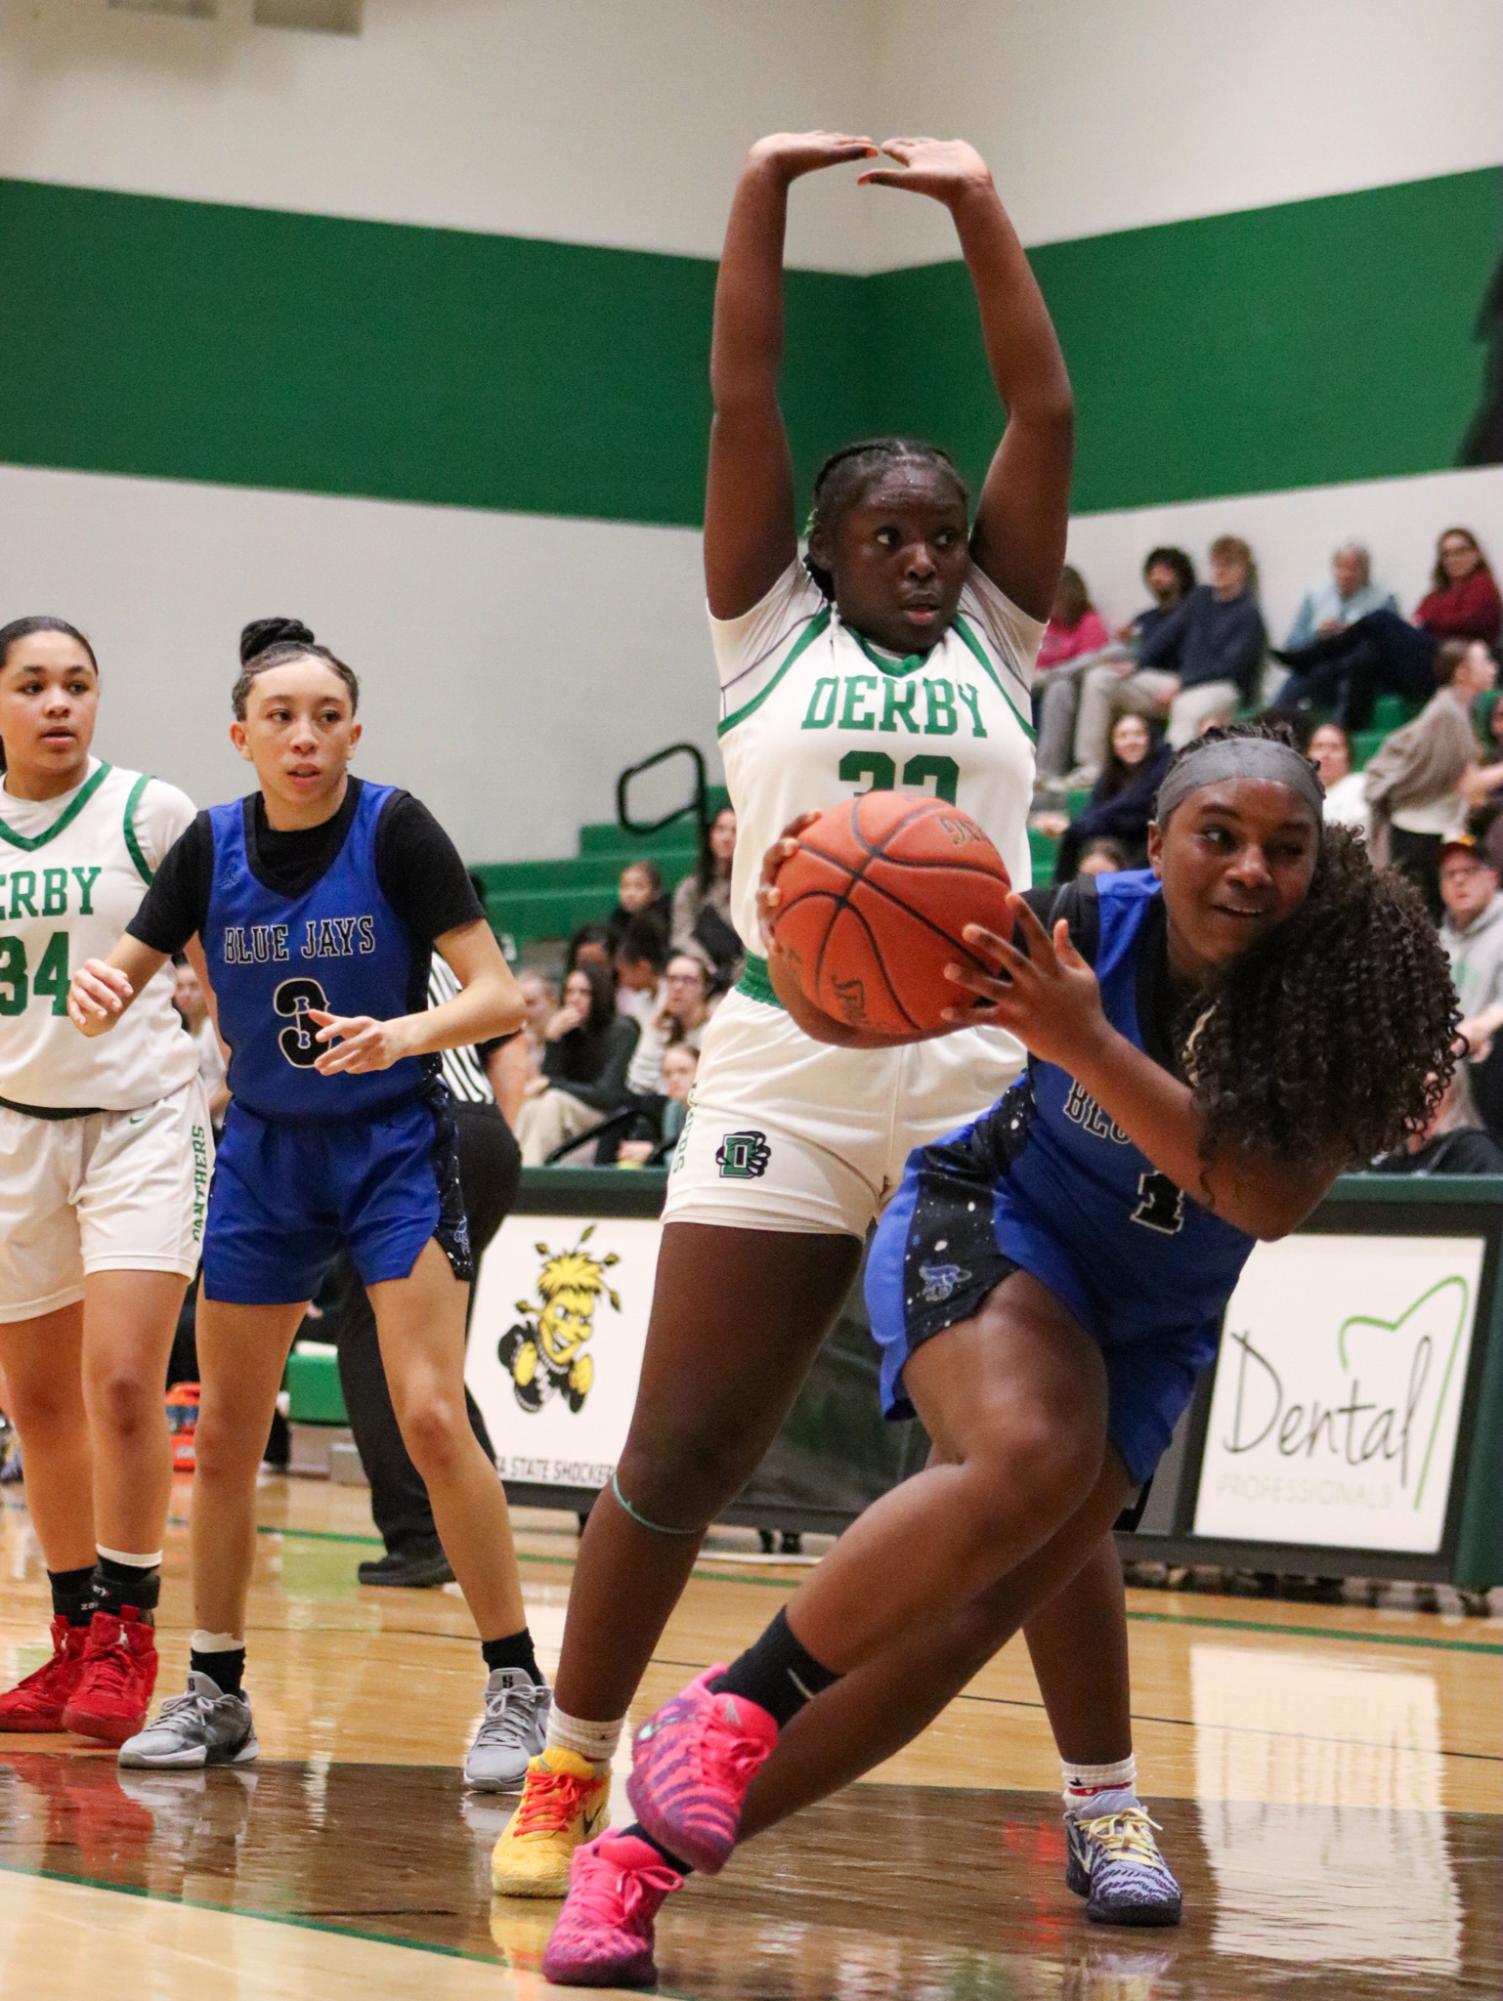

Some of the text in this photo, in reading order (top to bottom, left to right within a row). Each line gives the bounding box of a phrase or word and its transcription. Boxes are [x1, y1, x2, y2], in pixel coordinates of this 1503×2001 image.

[801, 674, 988, 739] DERBY
[0, 866, 102, 921] RBY
[224, 915, 376, 964] BLUE JAYS
[0, 930, 72, 1016] 34
[273, 977, 334, 1069] 3
[1222, 1328, 1432, 1490] Dental
[511, 1456, 549, 1480] STATE
